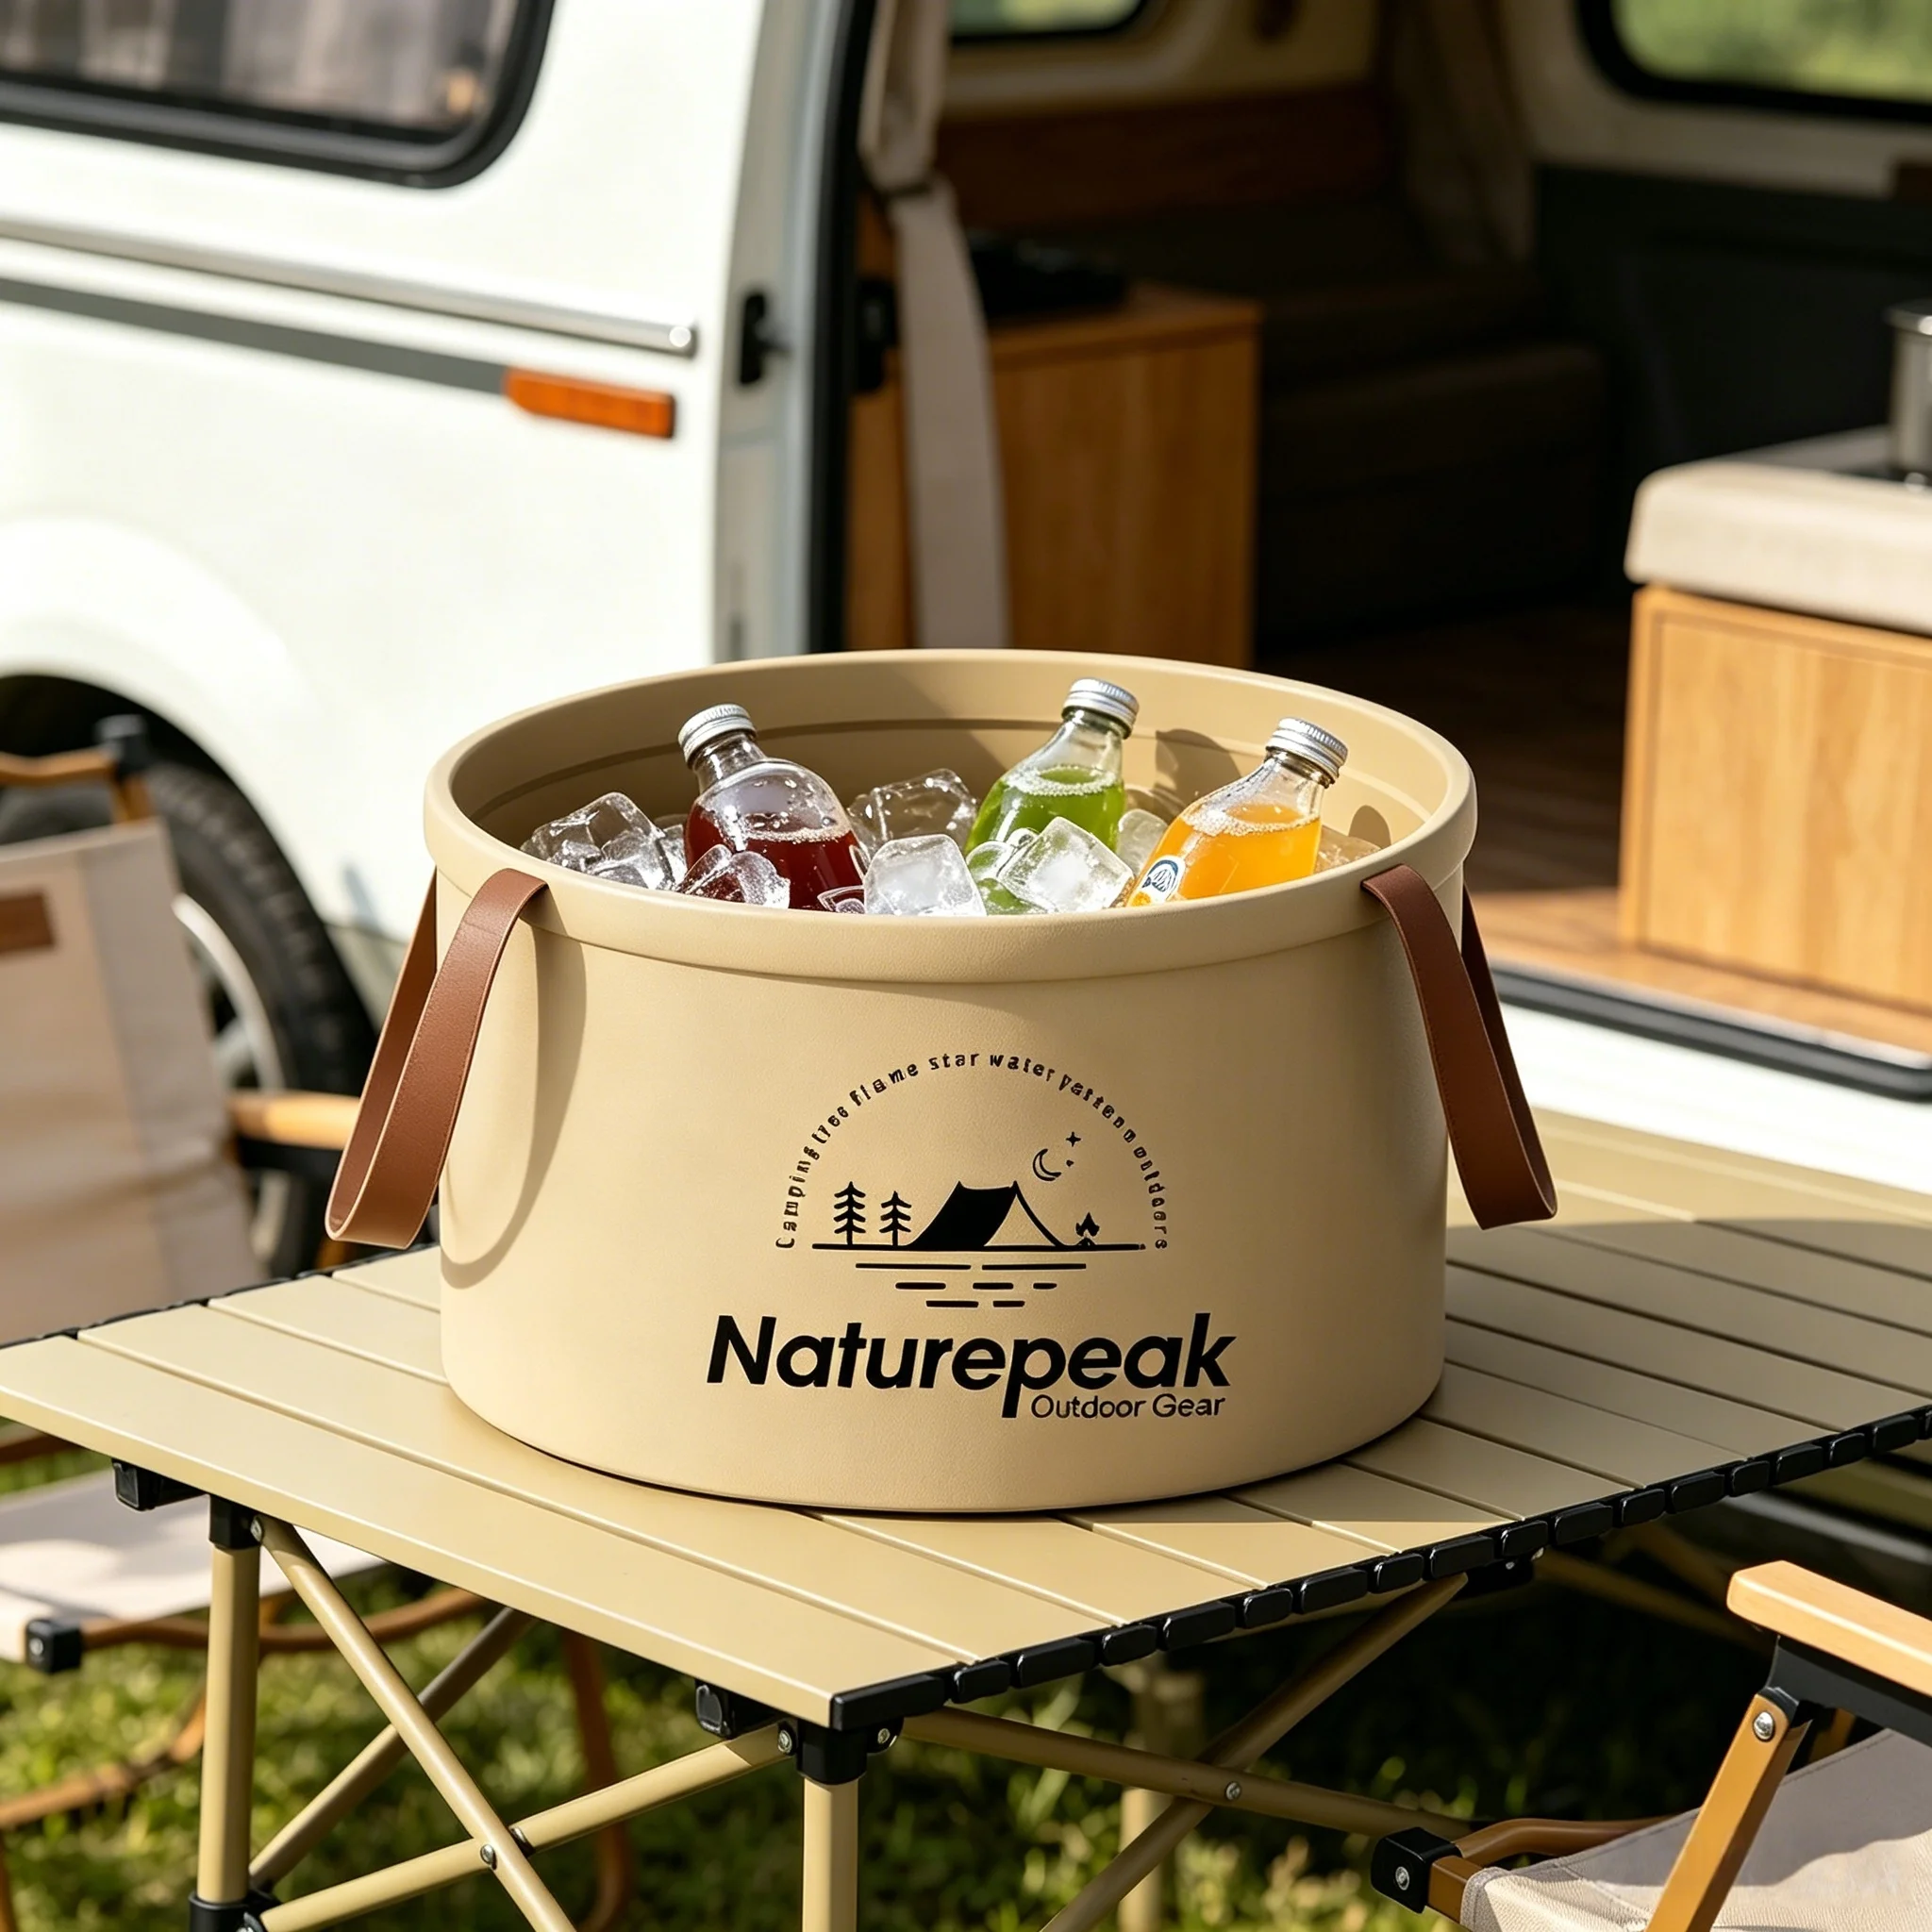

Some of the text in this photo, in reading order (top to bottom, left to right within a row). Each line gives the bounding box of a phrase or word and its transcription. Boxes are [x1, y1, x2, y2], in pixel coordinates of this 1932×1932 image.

[928, 1053, 979, 1071] star
[990, 1054, 1056, 1082] water
[707, 1312, 1237, 1419] Naturepeak
[1030, 1393, 1226, 1419] Outdoor Gear
